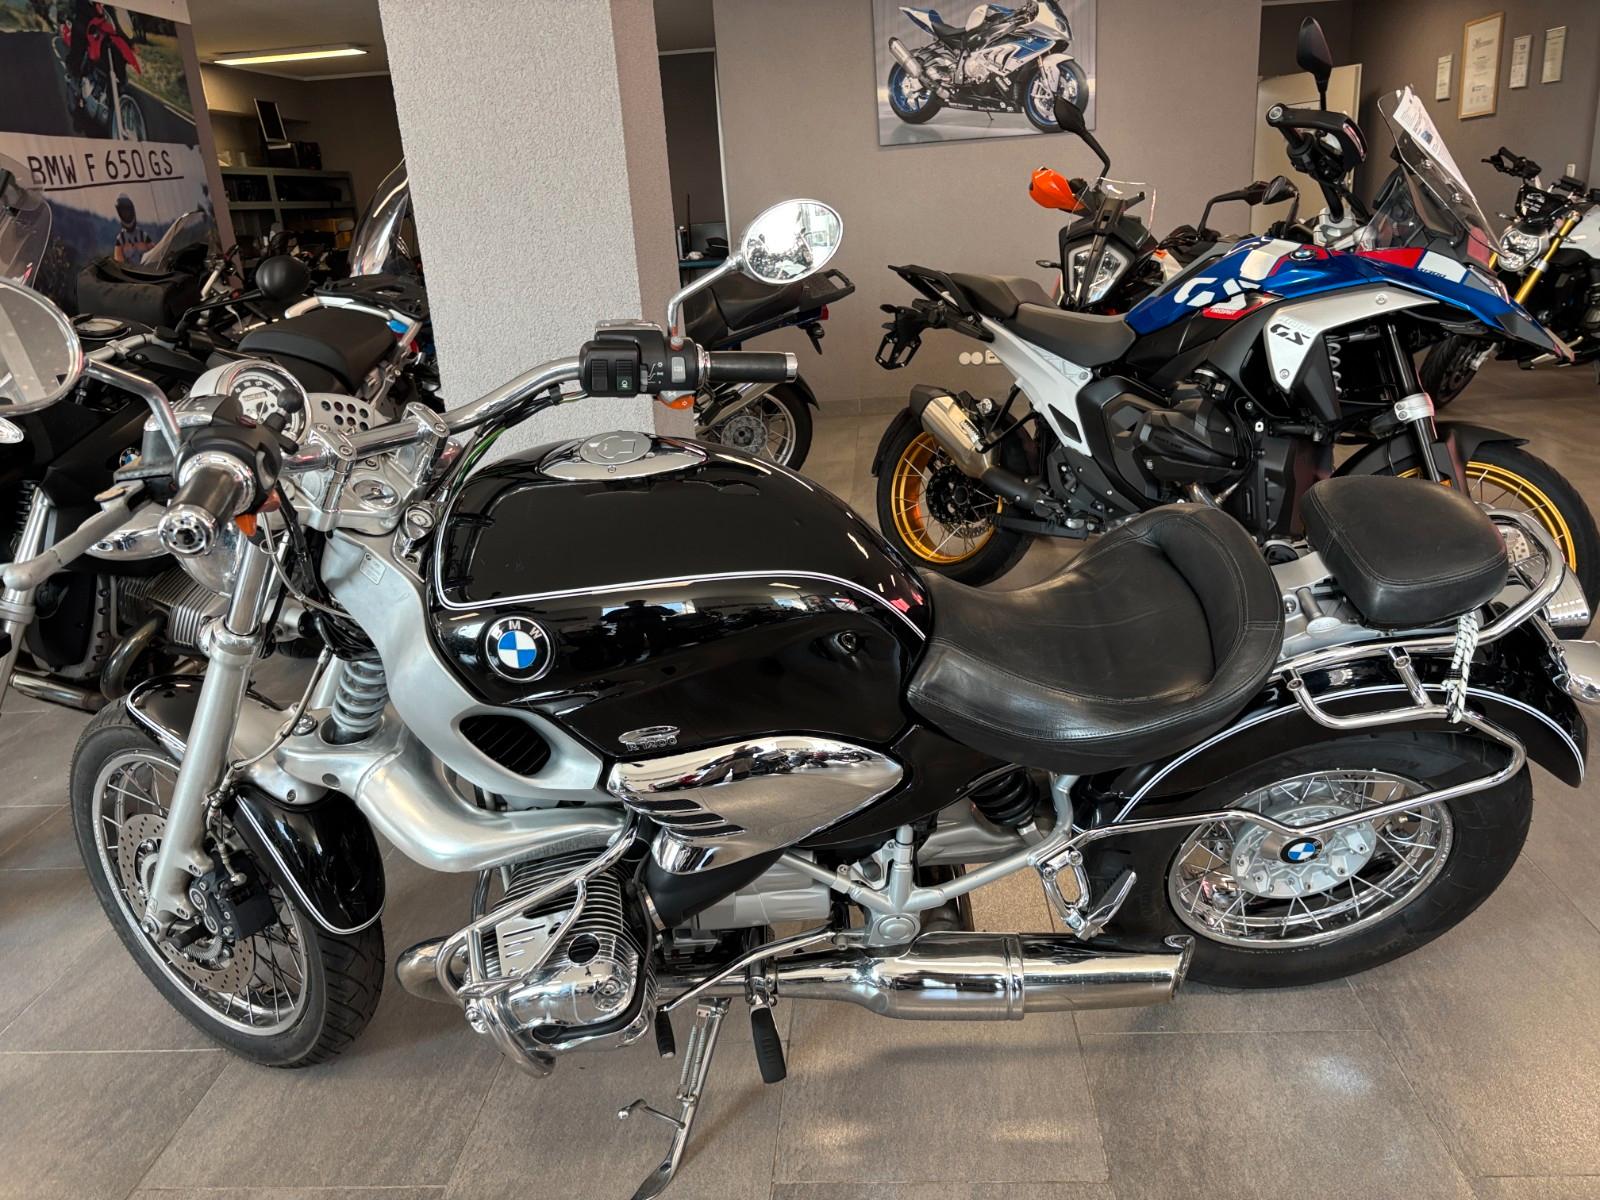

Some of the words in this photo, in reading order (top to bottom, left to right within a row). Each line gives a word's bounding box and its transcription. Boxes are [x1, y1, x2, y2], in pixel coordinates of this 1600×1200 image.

[27, 154, 78, 185] BMW
[85, 153, 96, 182] F
[1173, 277, 1261, 311] GS
[1270, 323, 1311, 346] GS
[490, 620, 543, 641] BMW
